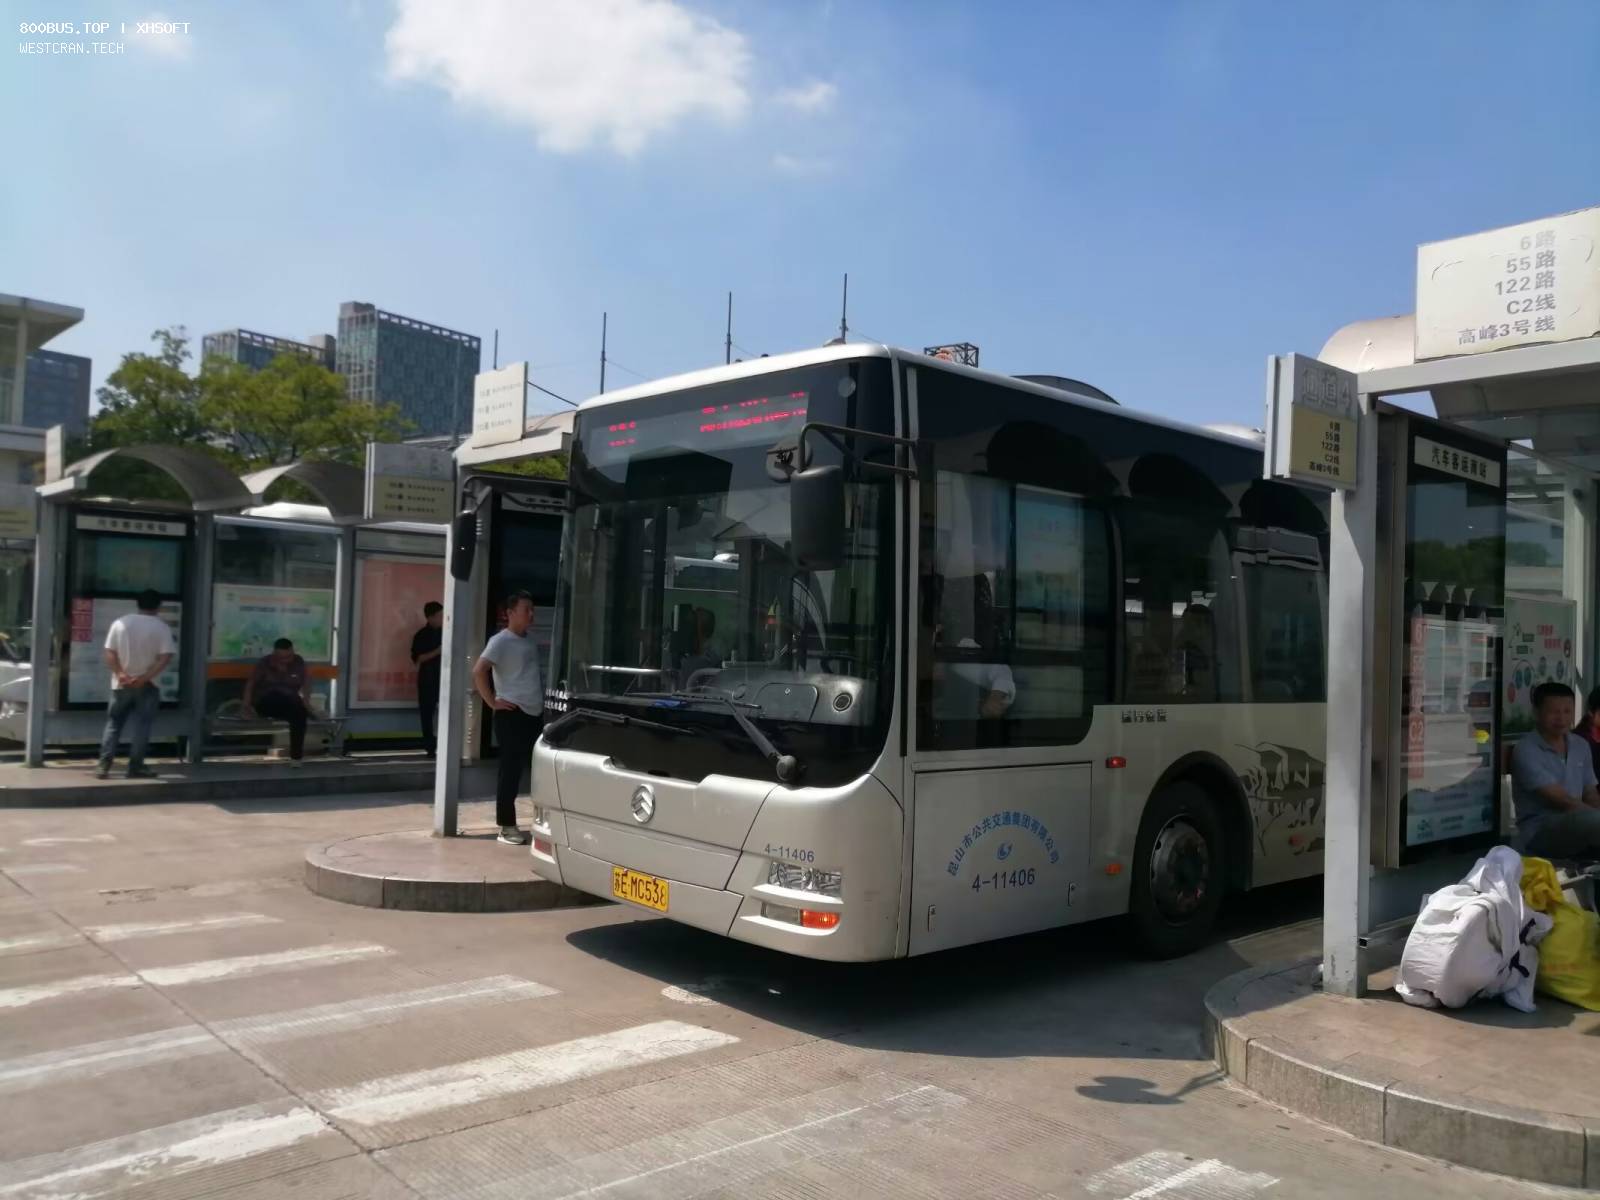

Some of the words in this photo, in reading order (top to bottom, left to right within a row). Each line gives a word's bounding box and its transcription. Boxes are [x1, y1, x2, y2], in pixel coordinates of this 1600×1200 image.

[1520, 230, 1556, 250] 6路
[1506, 250, 1556, 274] 55路
[1495, 270, 1556, 295] 122路
[1506, 294, 1556, 315] C2线
[1458, 315, 1556, 346] 高峰3号线
[764, 844, 815, 863] 4-11406
[947, 811, 1060, 877] 昆山市公共交通集团有限公司
[972, 867, 1036, 893] 4-11406
